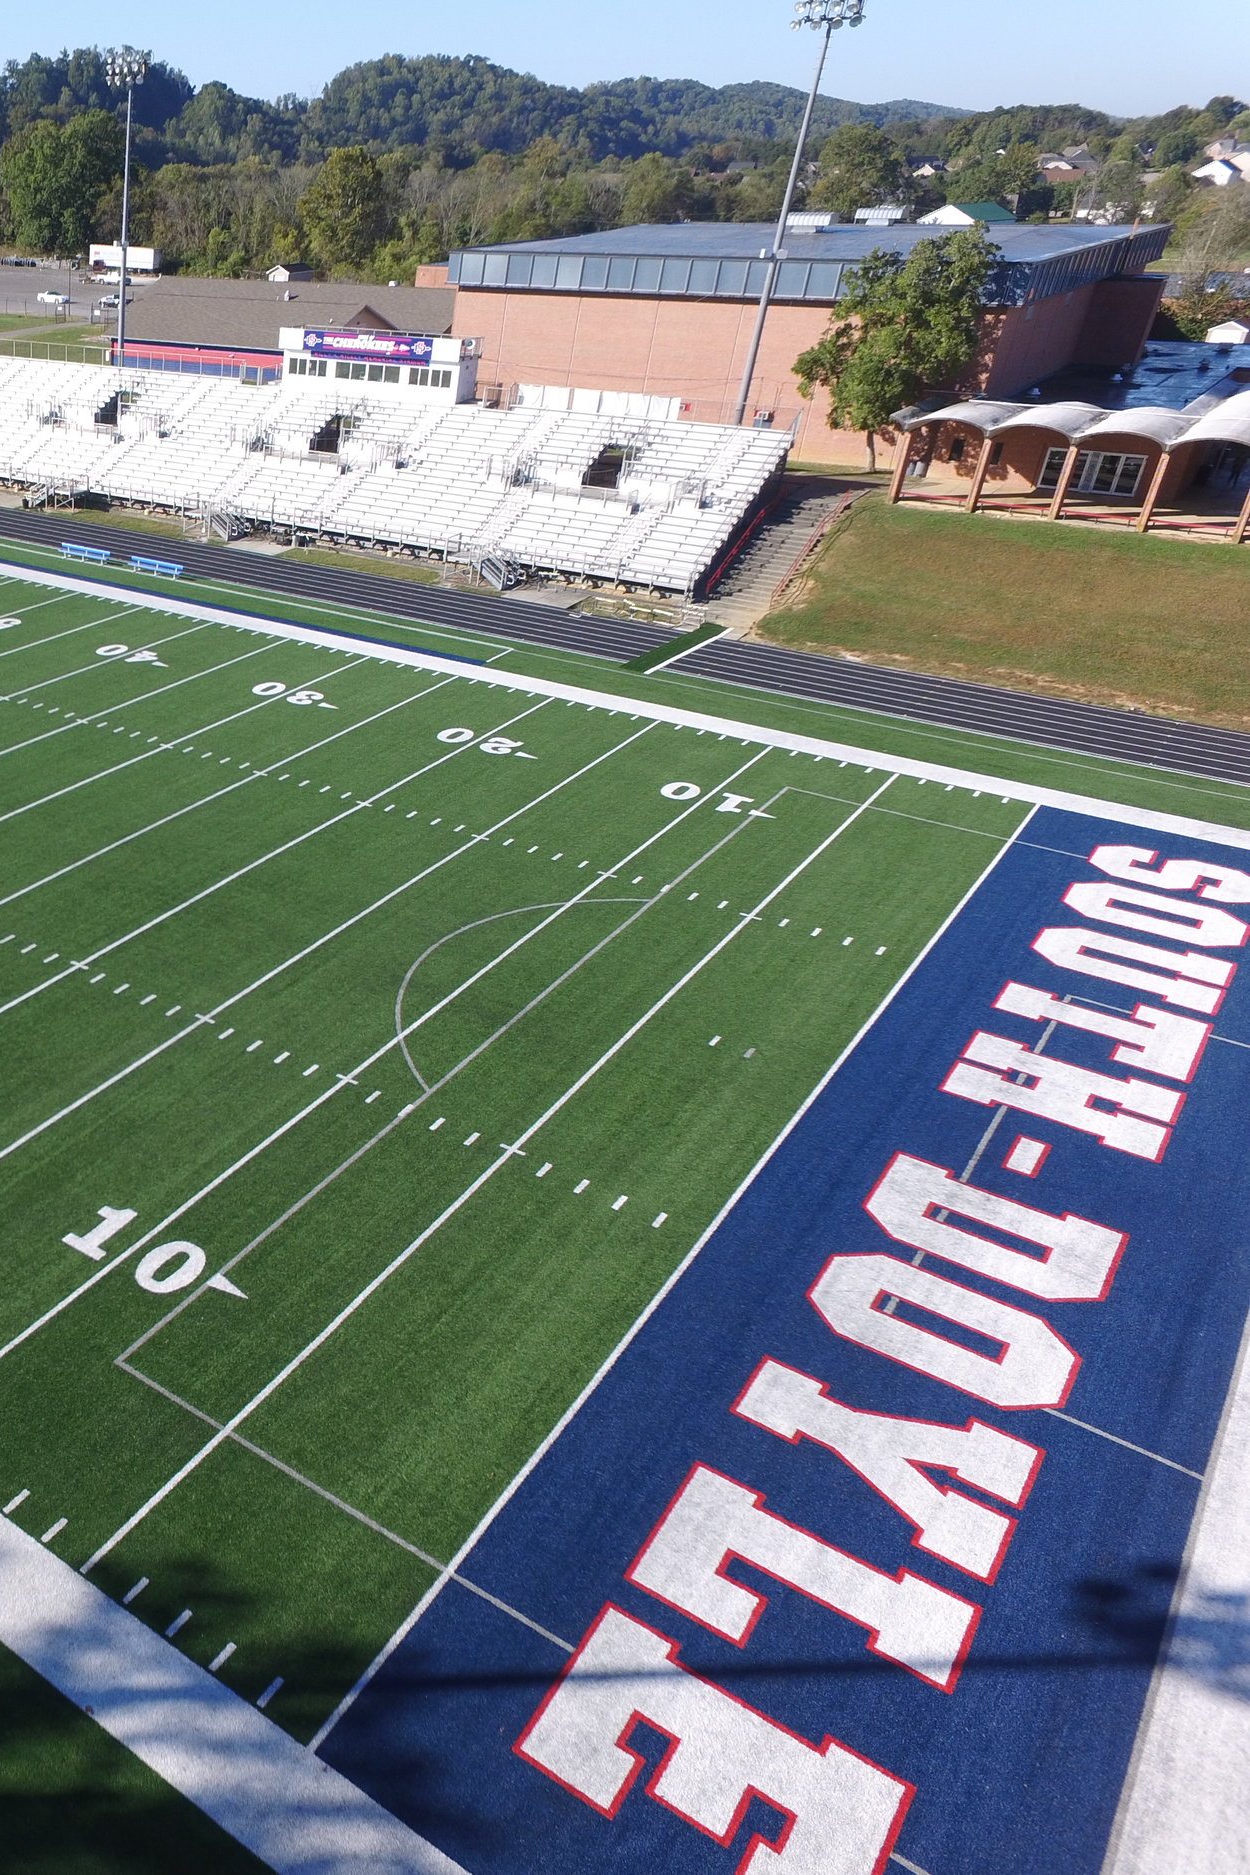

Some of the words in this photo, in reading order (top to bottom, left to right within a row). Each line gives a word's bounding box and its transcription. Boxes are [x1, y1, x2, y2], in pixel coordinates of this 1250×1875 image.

[95, 644, 159, 663] 40
[251, 681, 324, 706] 30
[436, 727, 524, 755] 20
[660, 781, 754, 813] 10
[61, 1205, 206, 1294] 10
